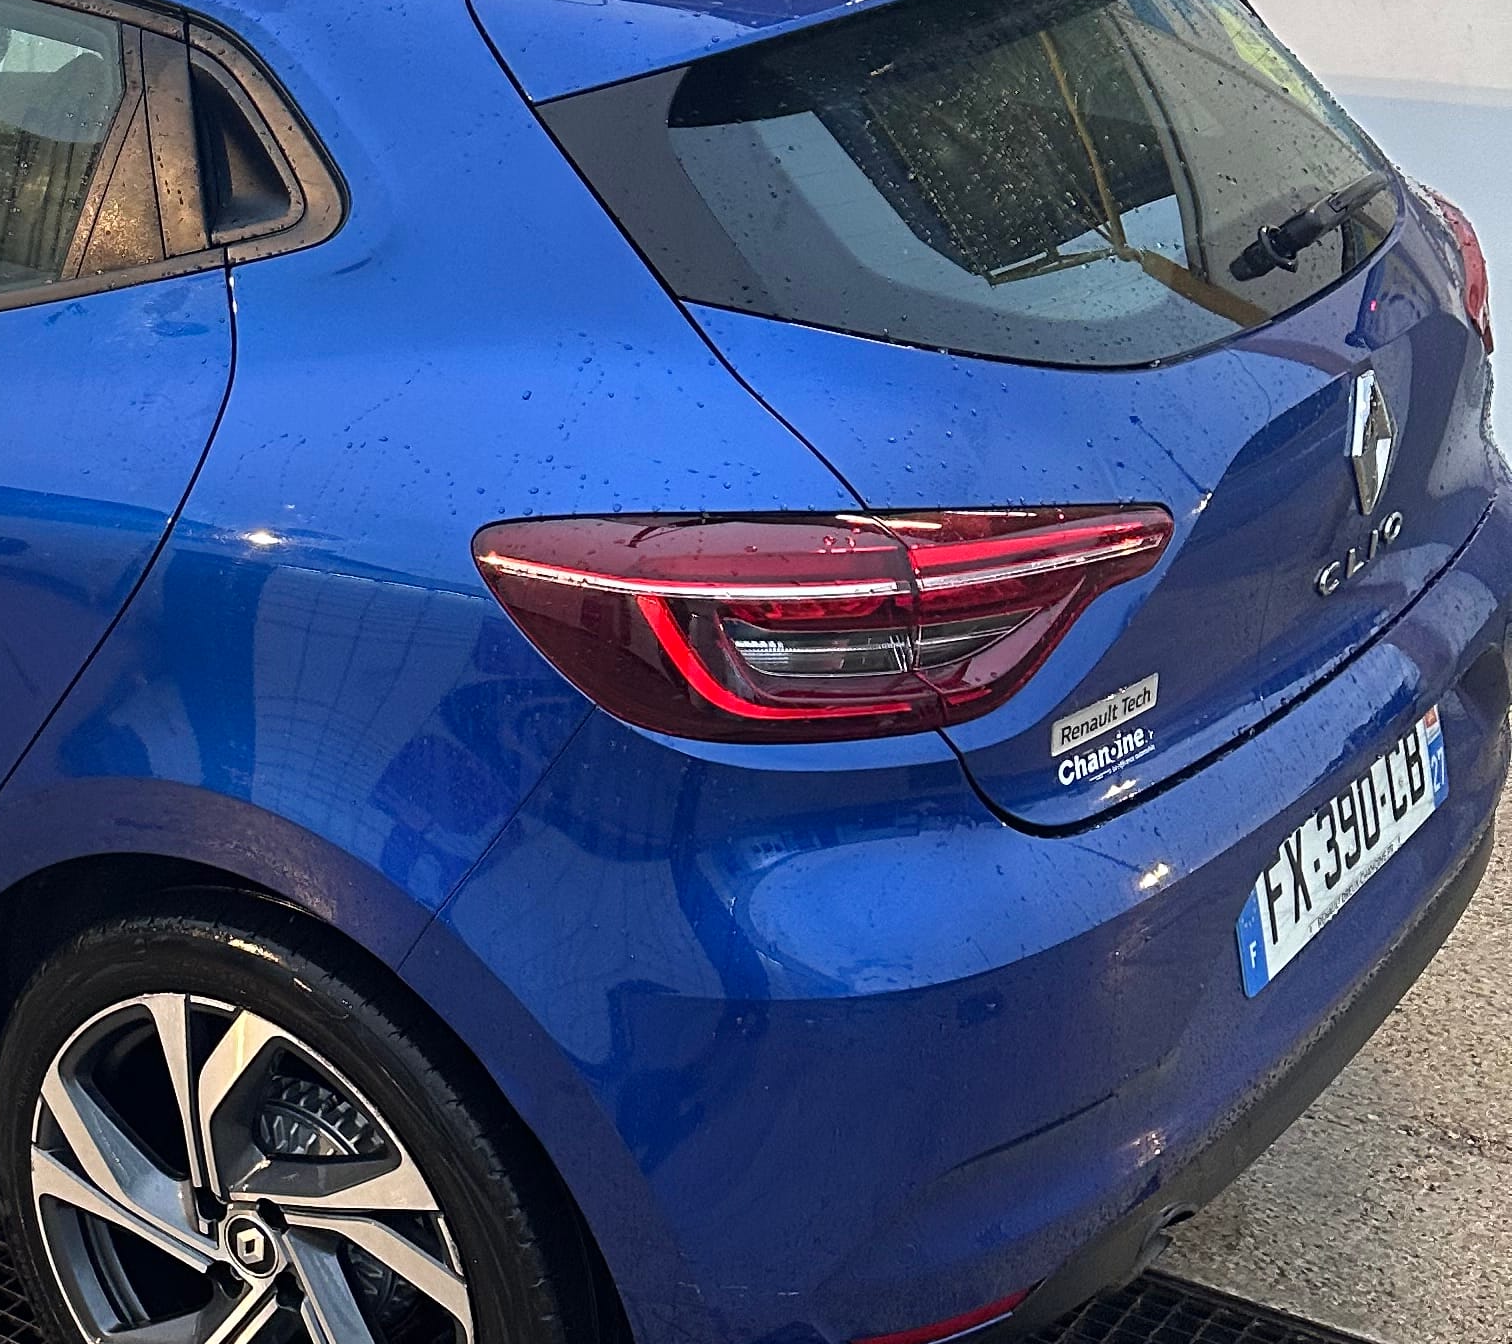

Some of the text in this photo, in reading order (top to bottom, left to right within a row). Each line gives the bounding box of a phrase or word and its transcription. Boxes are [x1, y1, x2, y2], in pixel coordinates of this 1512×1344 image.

[1318, 511, 1403, 596] CLIO
[1061, 687, 1151, 745] Renault Tech
[1249, 730, 1445, 968] F FX-390-CB 27
